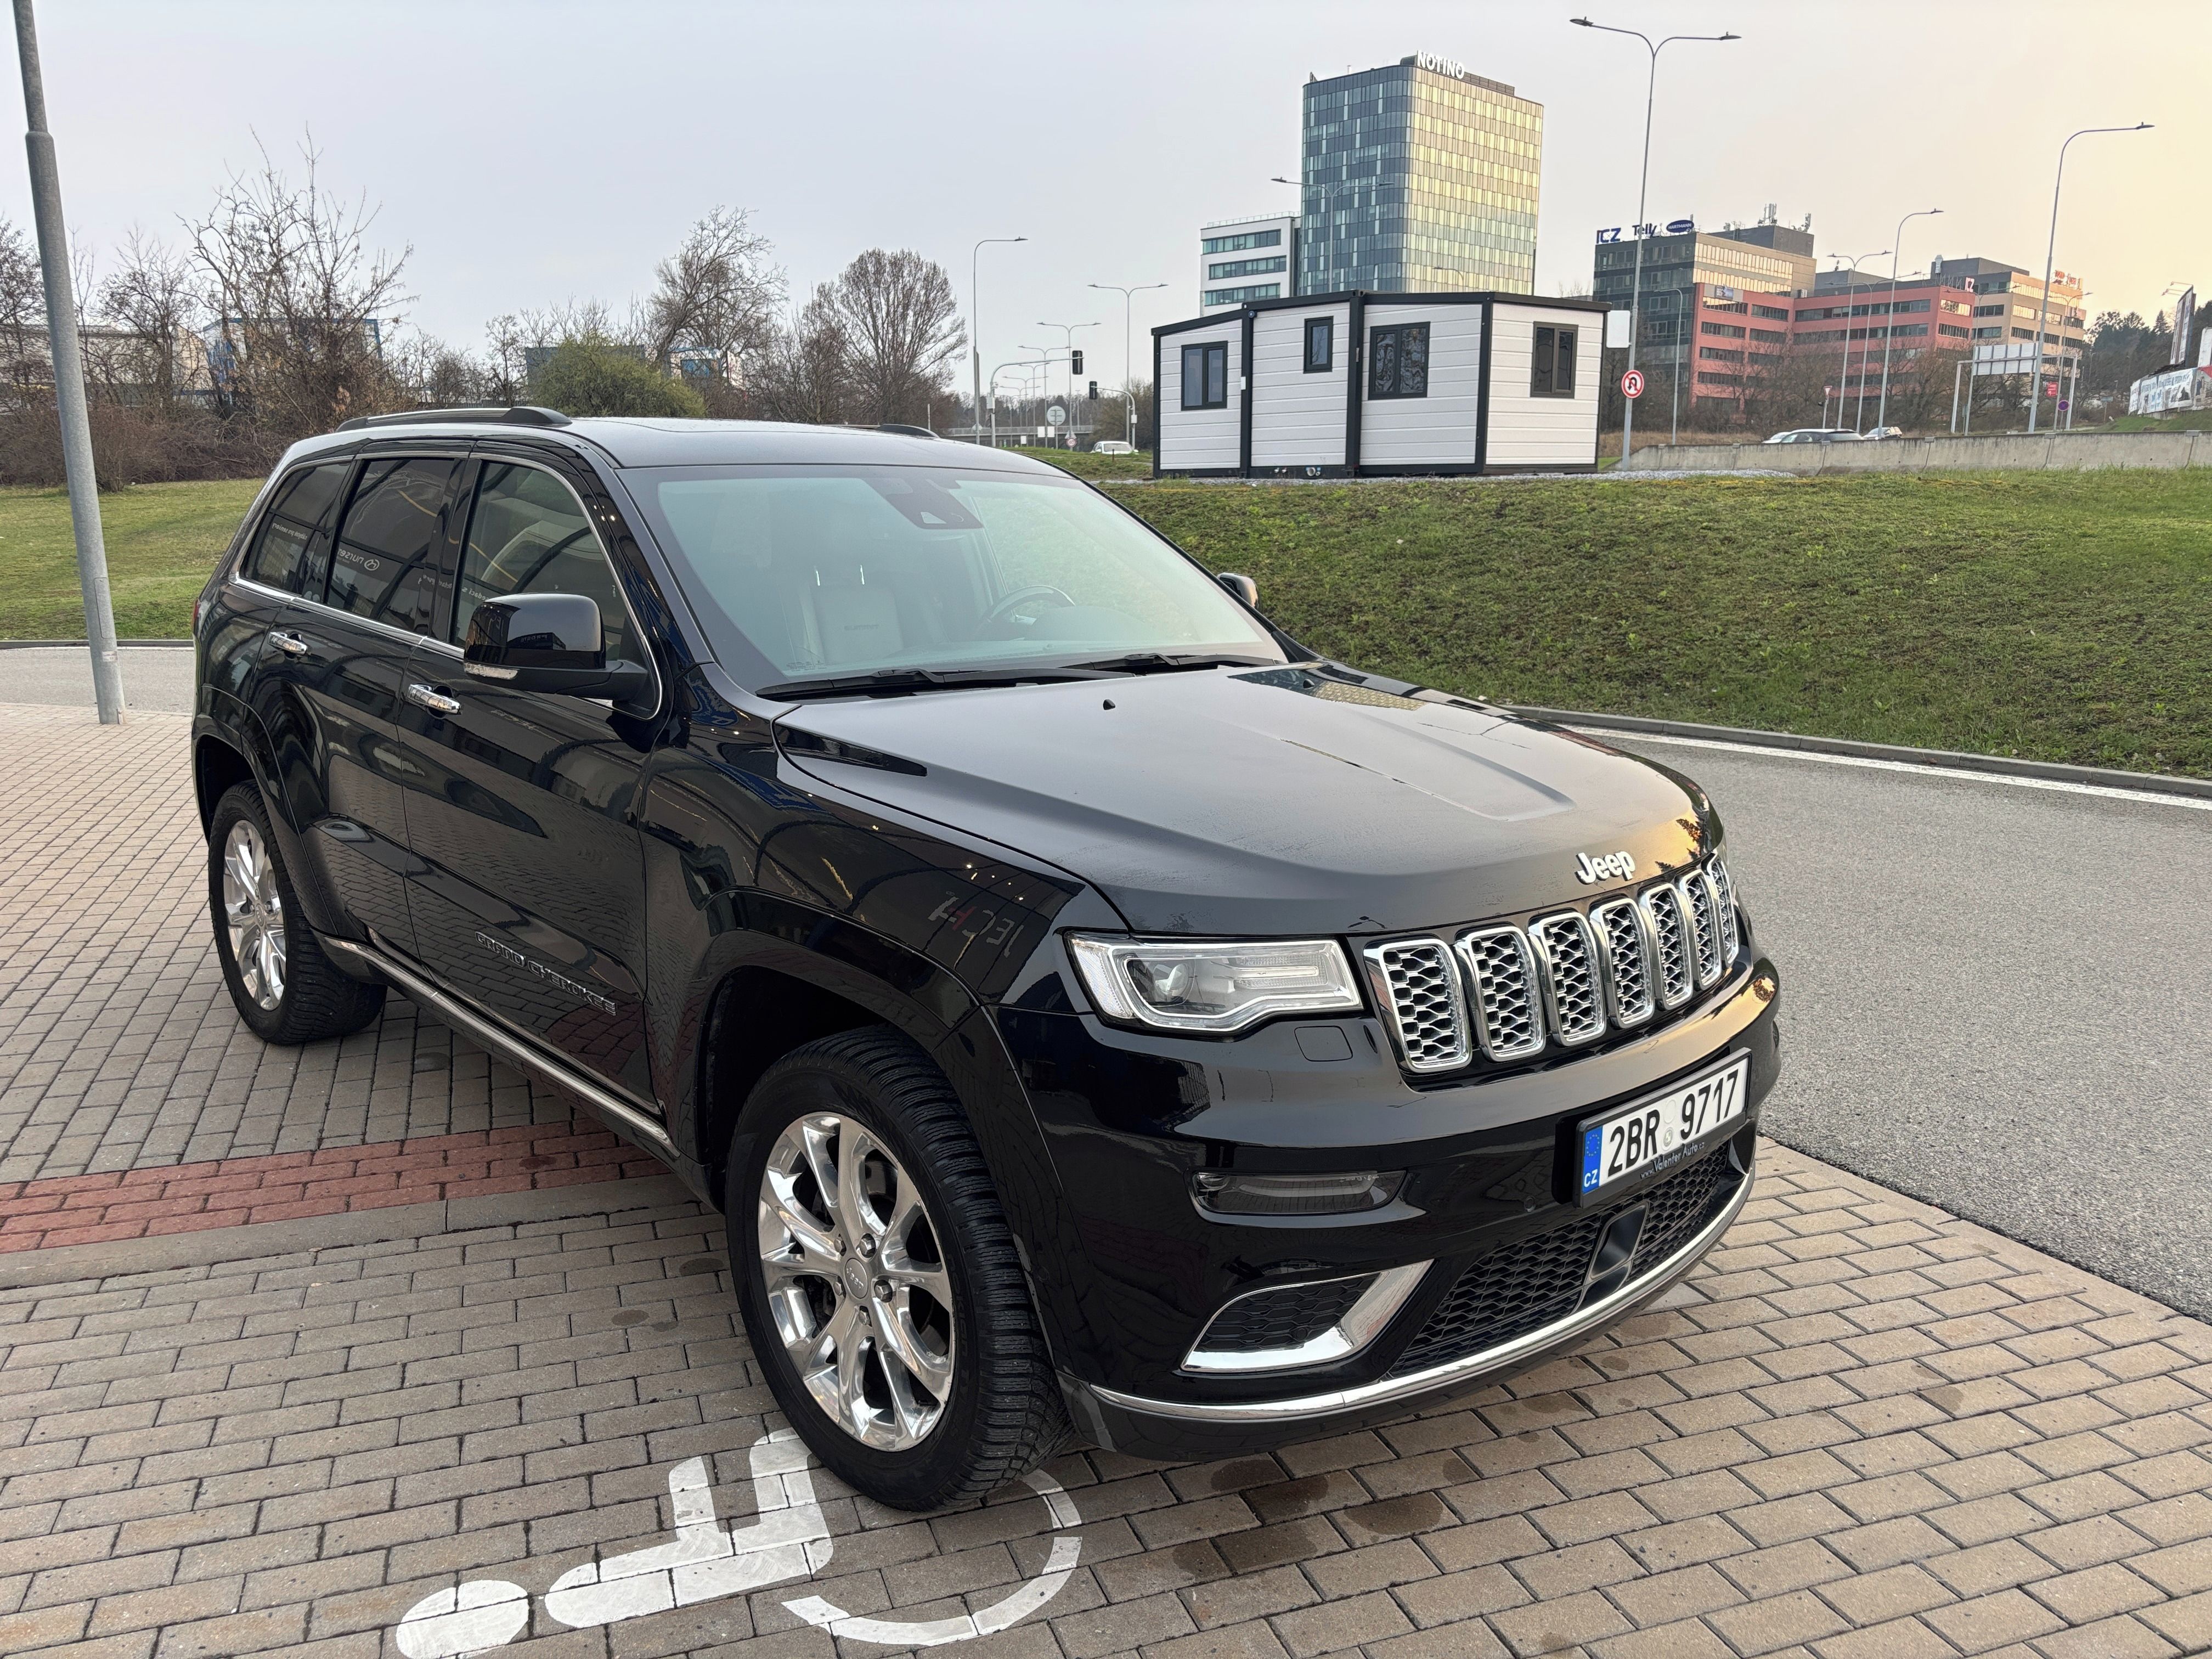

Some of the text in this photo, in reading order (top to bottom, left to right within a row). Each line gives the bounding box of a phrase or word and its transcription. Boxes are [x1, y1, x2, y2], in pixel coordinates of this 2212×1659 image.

[1417, 50, 1465, 79] NOTINO
[1596, 227, 1621, 244] ICZ
[1575, 851, 1635, 884] Jeep
[475, 931, 617, 1016] GRAND CHEROKEE
[1607, 1069, 1739, 1179] 2BR 9717
[1584, 1169, 1598, 1188] CZ
